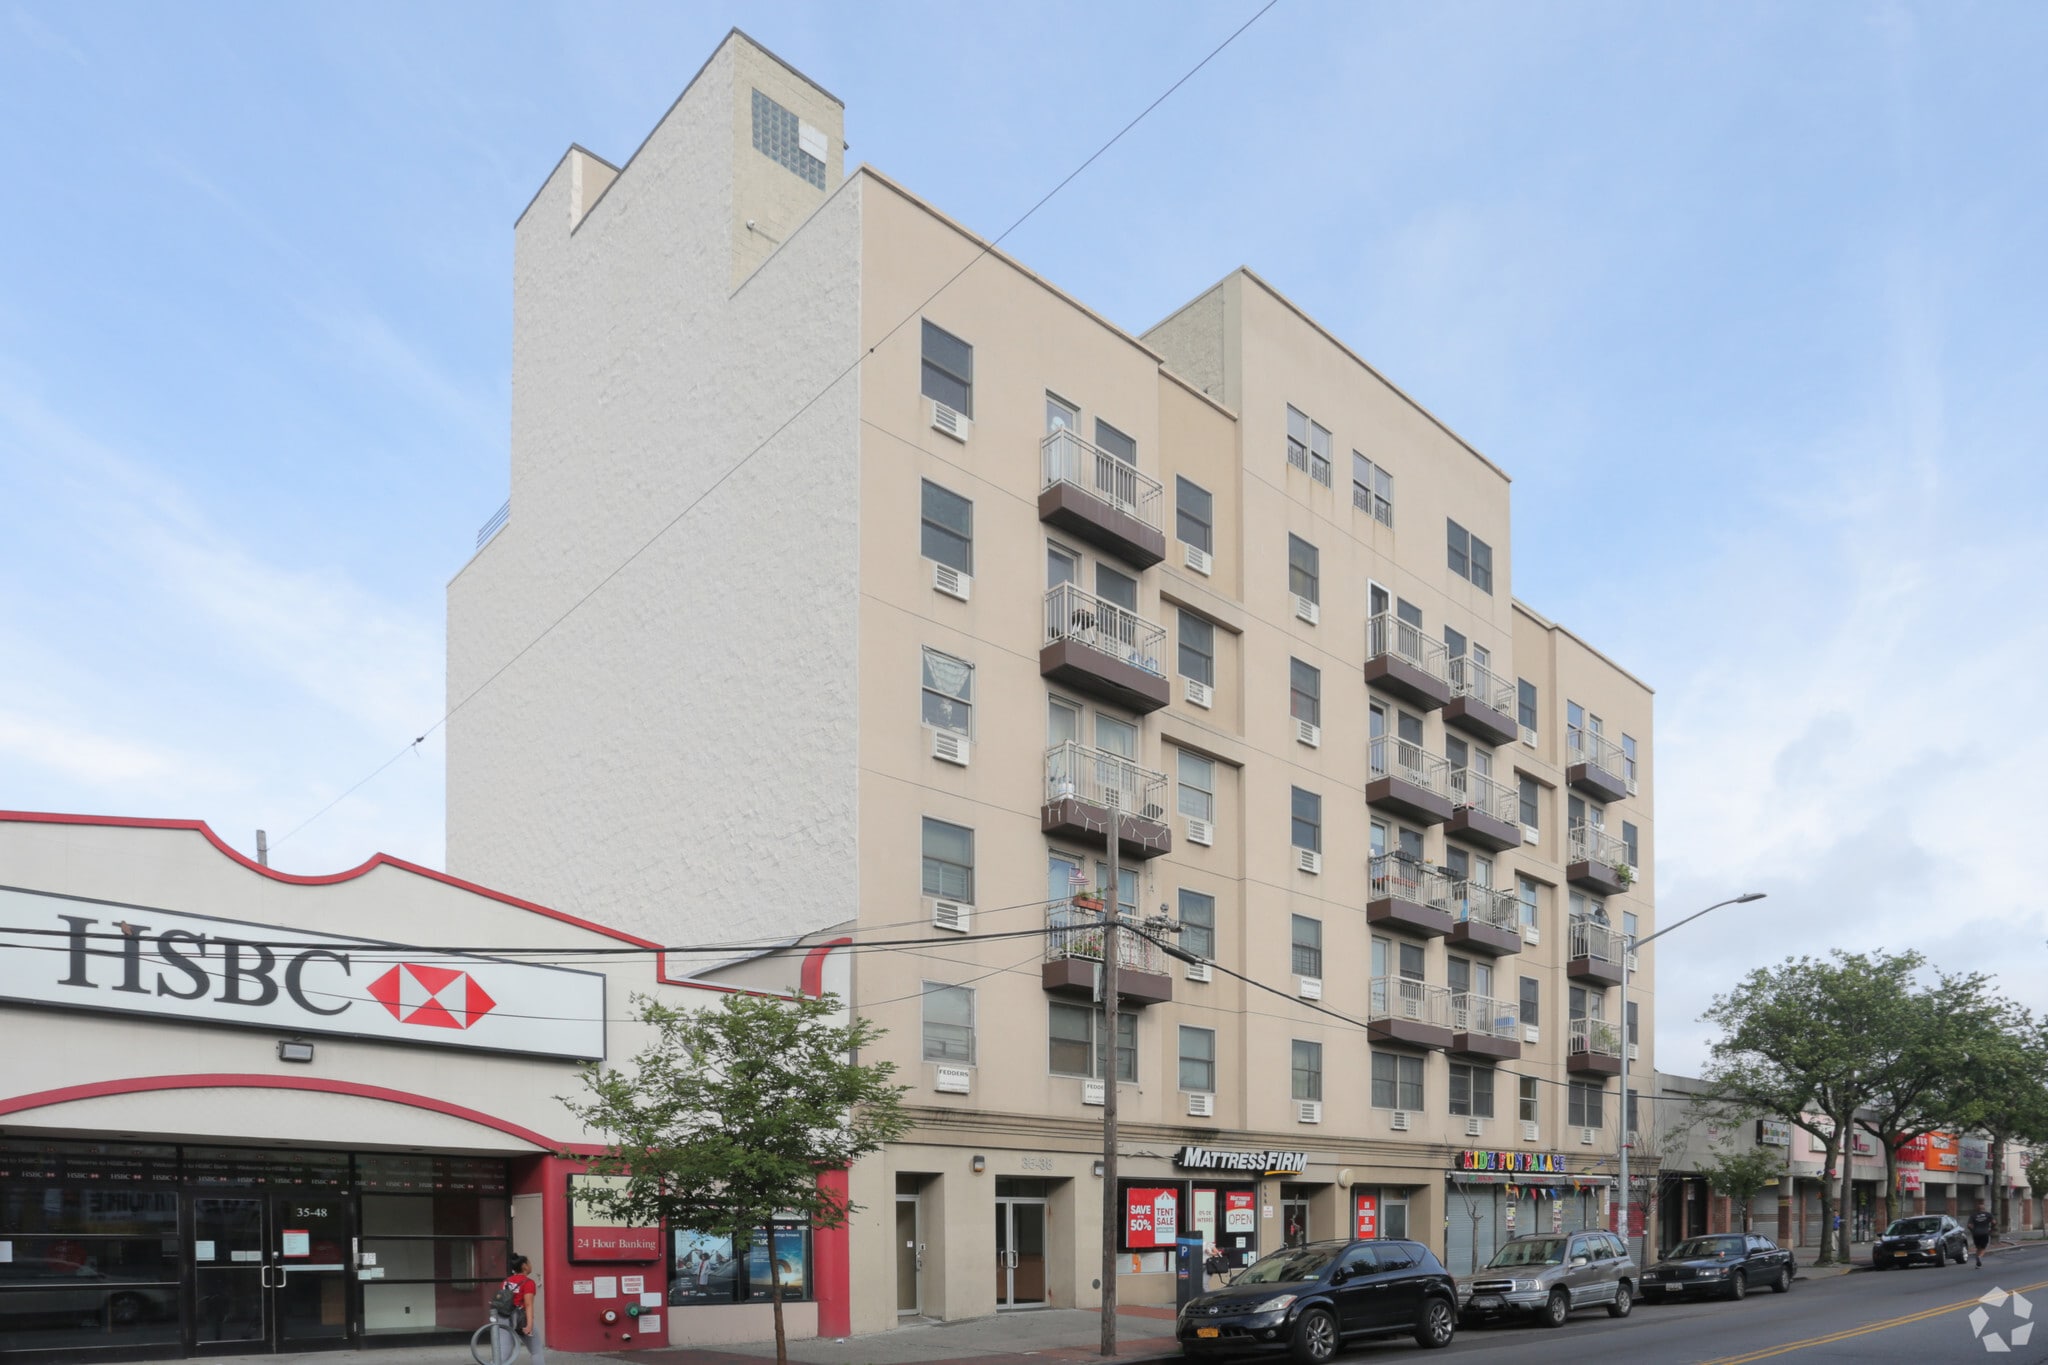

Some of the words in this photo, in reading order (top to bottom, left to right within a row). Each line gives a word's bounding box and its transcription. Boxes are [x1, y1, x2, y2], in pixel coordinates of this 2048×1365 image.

[57, 914, 353, 1016] HSBC
[939, 1069, 969, 1077] FEDDERS
[1464, 1151, 1495, 1169] KIDZ
[1498, 1152, 1523, 1171] FUN
[1524, 1154, 1566, 1172] PALACE
[296, 1208, 328, 1217] 35-48
[1130, 1205, 1151, 1214] SAVE
[1156, 1208, 1174, 1216] TENT
[1130, 1219, 1152, 1231] 50%
[1156, 1217, 1174, 1226] SALE
[1229, 1213, 1252, 1225] OPEN
[577, 1239, 589, 1248] 24
[592, 1239, 616, 1249] Hour
[619, 1239, 656, 1251] Banking
[1181, 1245, 1188, 1257] P
